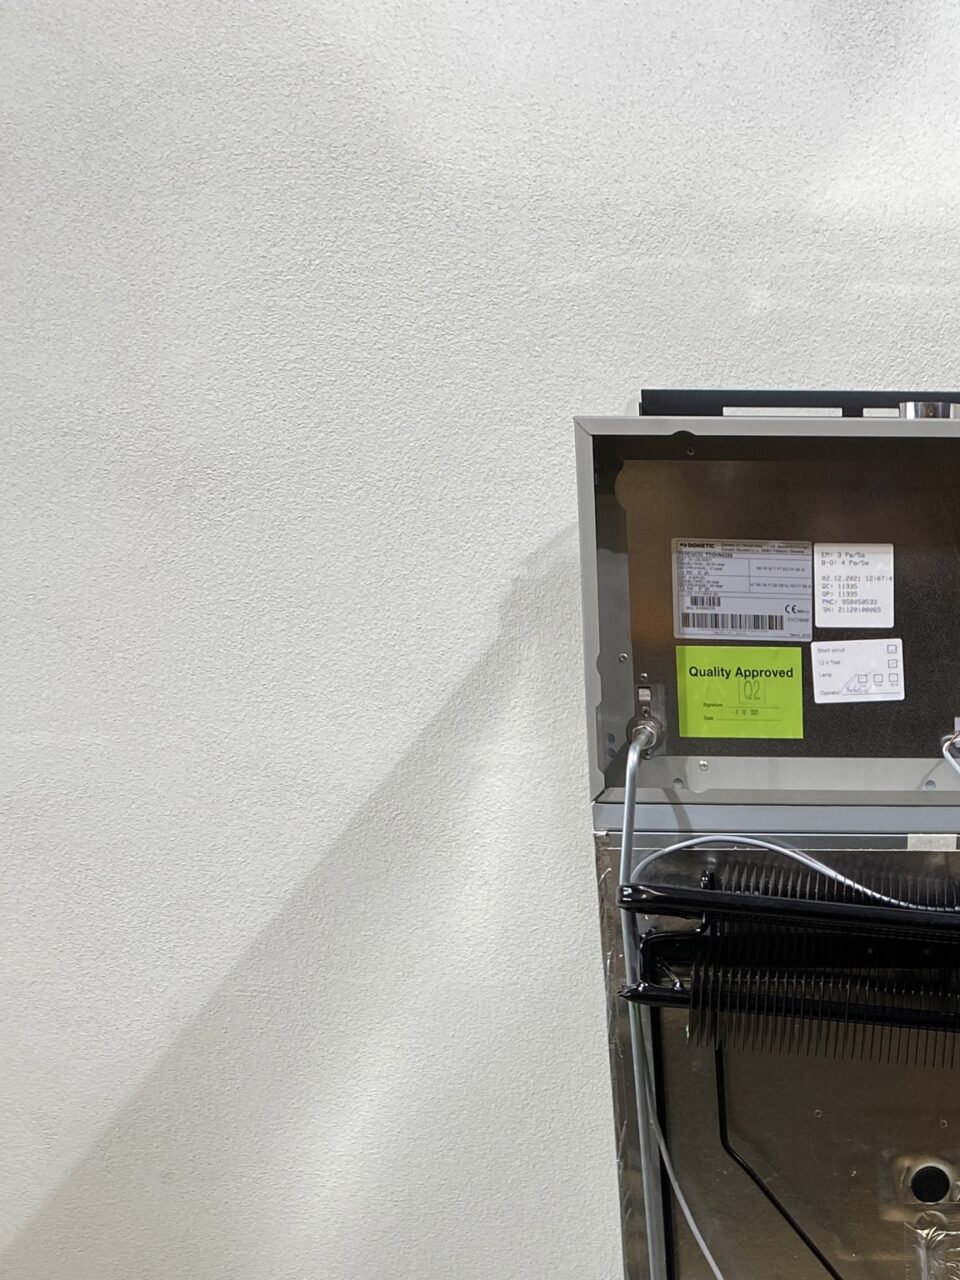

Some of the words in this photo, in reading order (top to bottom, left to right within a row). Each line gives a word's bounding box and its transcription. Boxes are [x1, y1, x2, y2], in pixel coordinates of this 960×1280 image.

[688, 666, 731, 679] Quality
[735, 667, 793, 679] Approved
[743, 680, 760, 700] Q2
